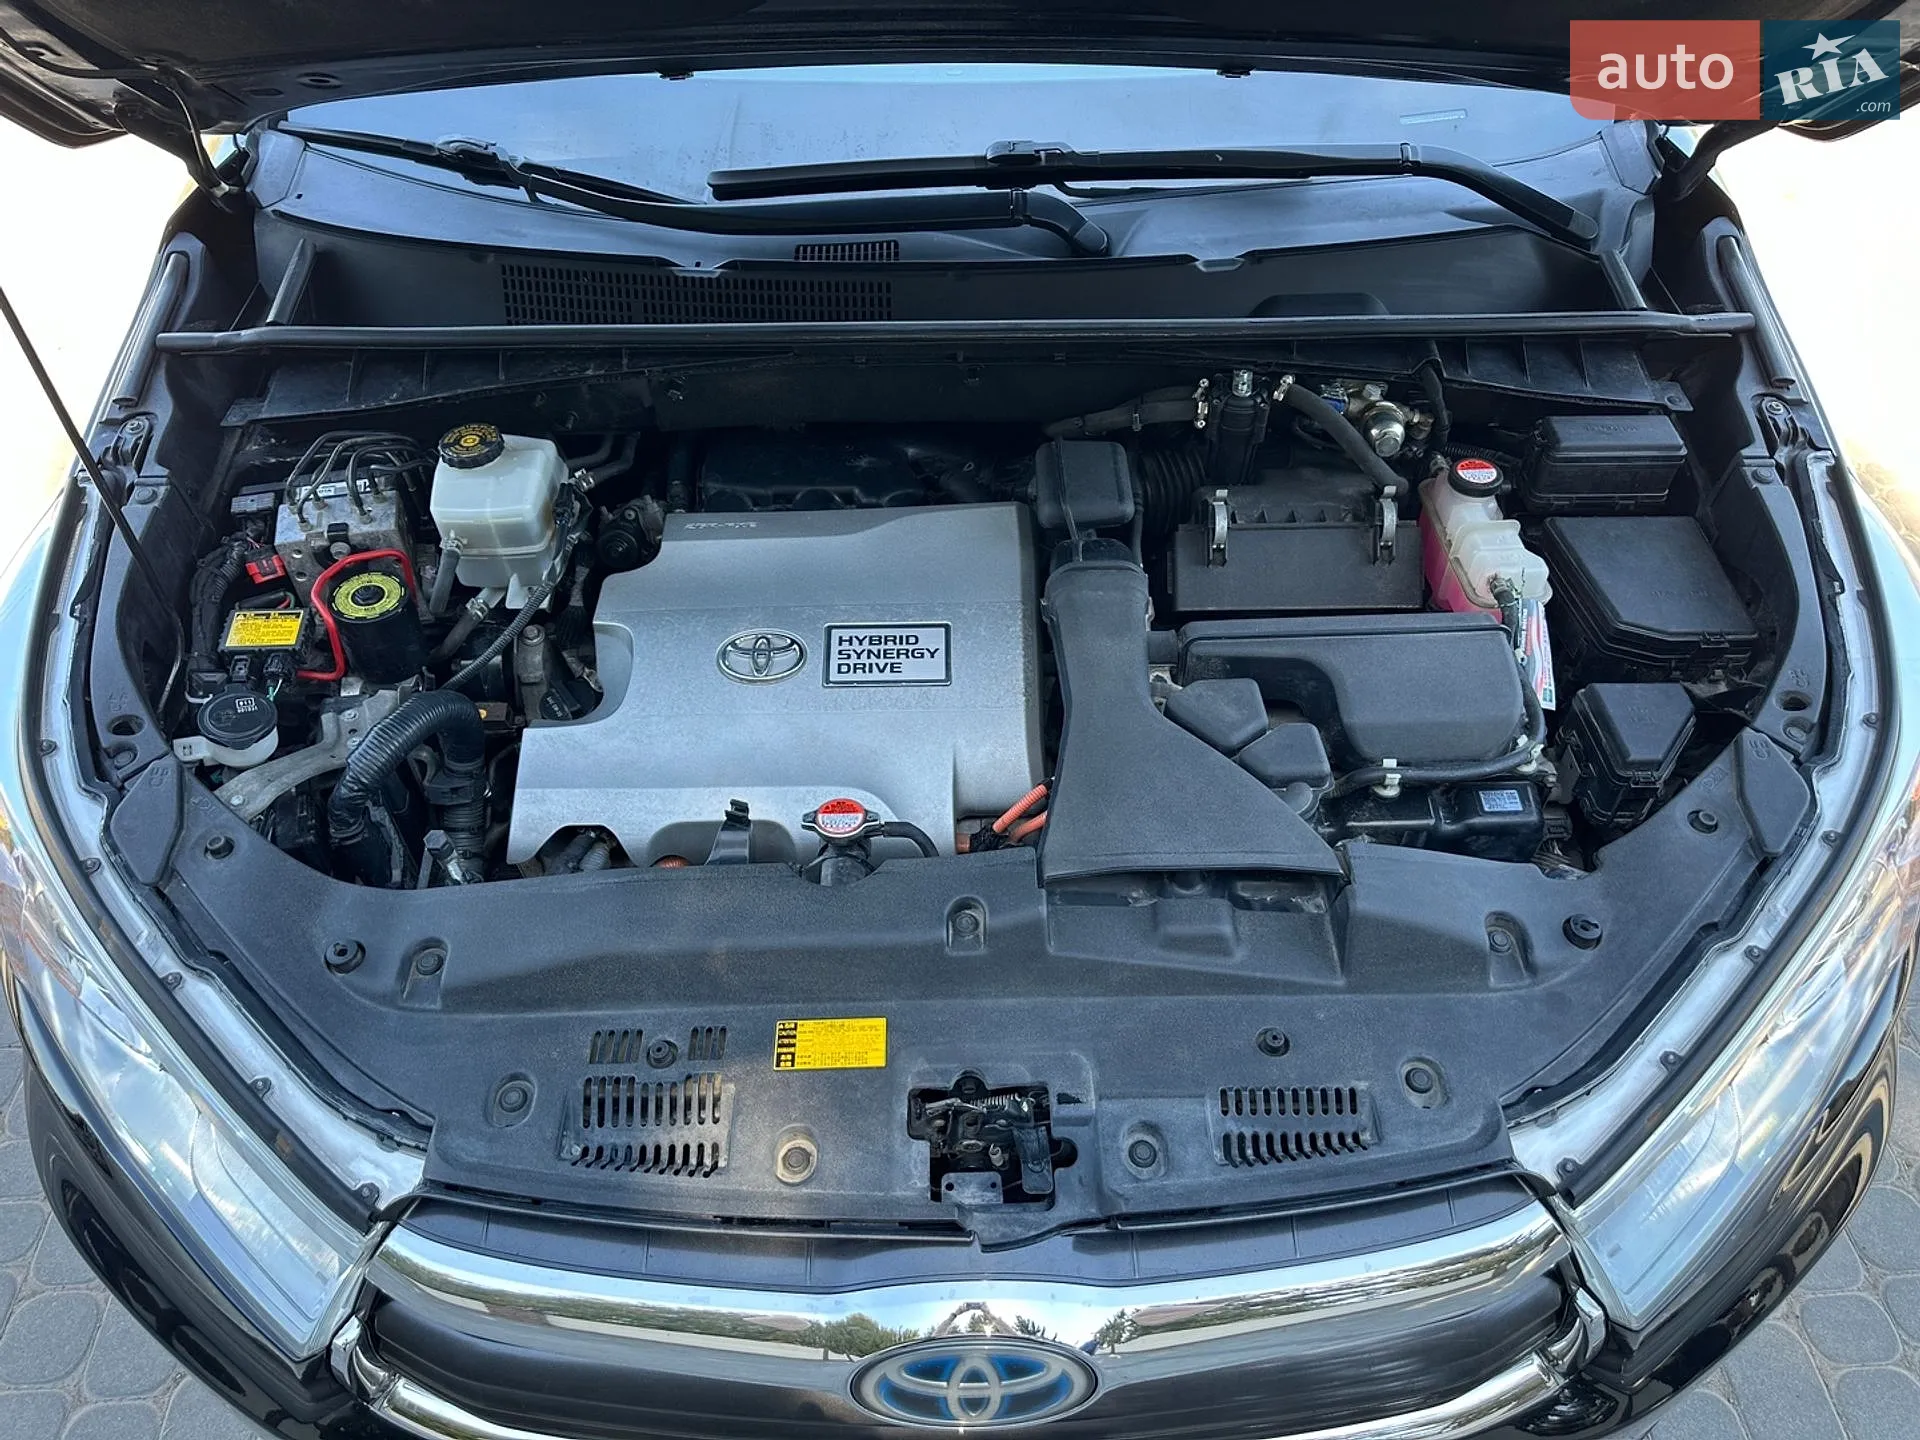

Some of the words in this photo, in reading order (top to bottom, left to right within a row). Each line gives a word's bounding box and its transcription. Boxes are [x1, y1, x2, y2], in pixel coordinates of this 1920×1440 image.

[838, 635, 919, 646] HYBRID
[837, 648, 940, 660] SYNERGY
[837, 662, 903, 674] DRIVE
